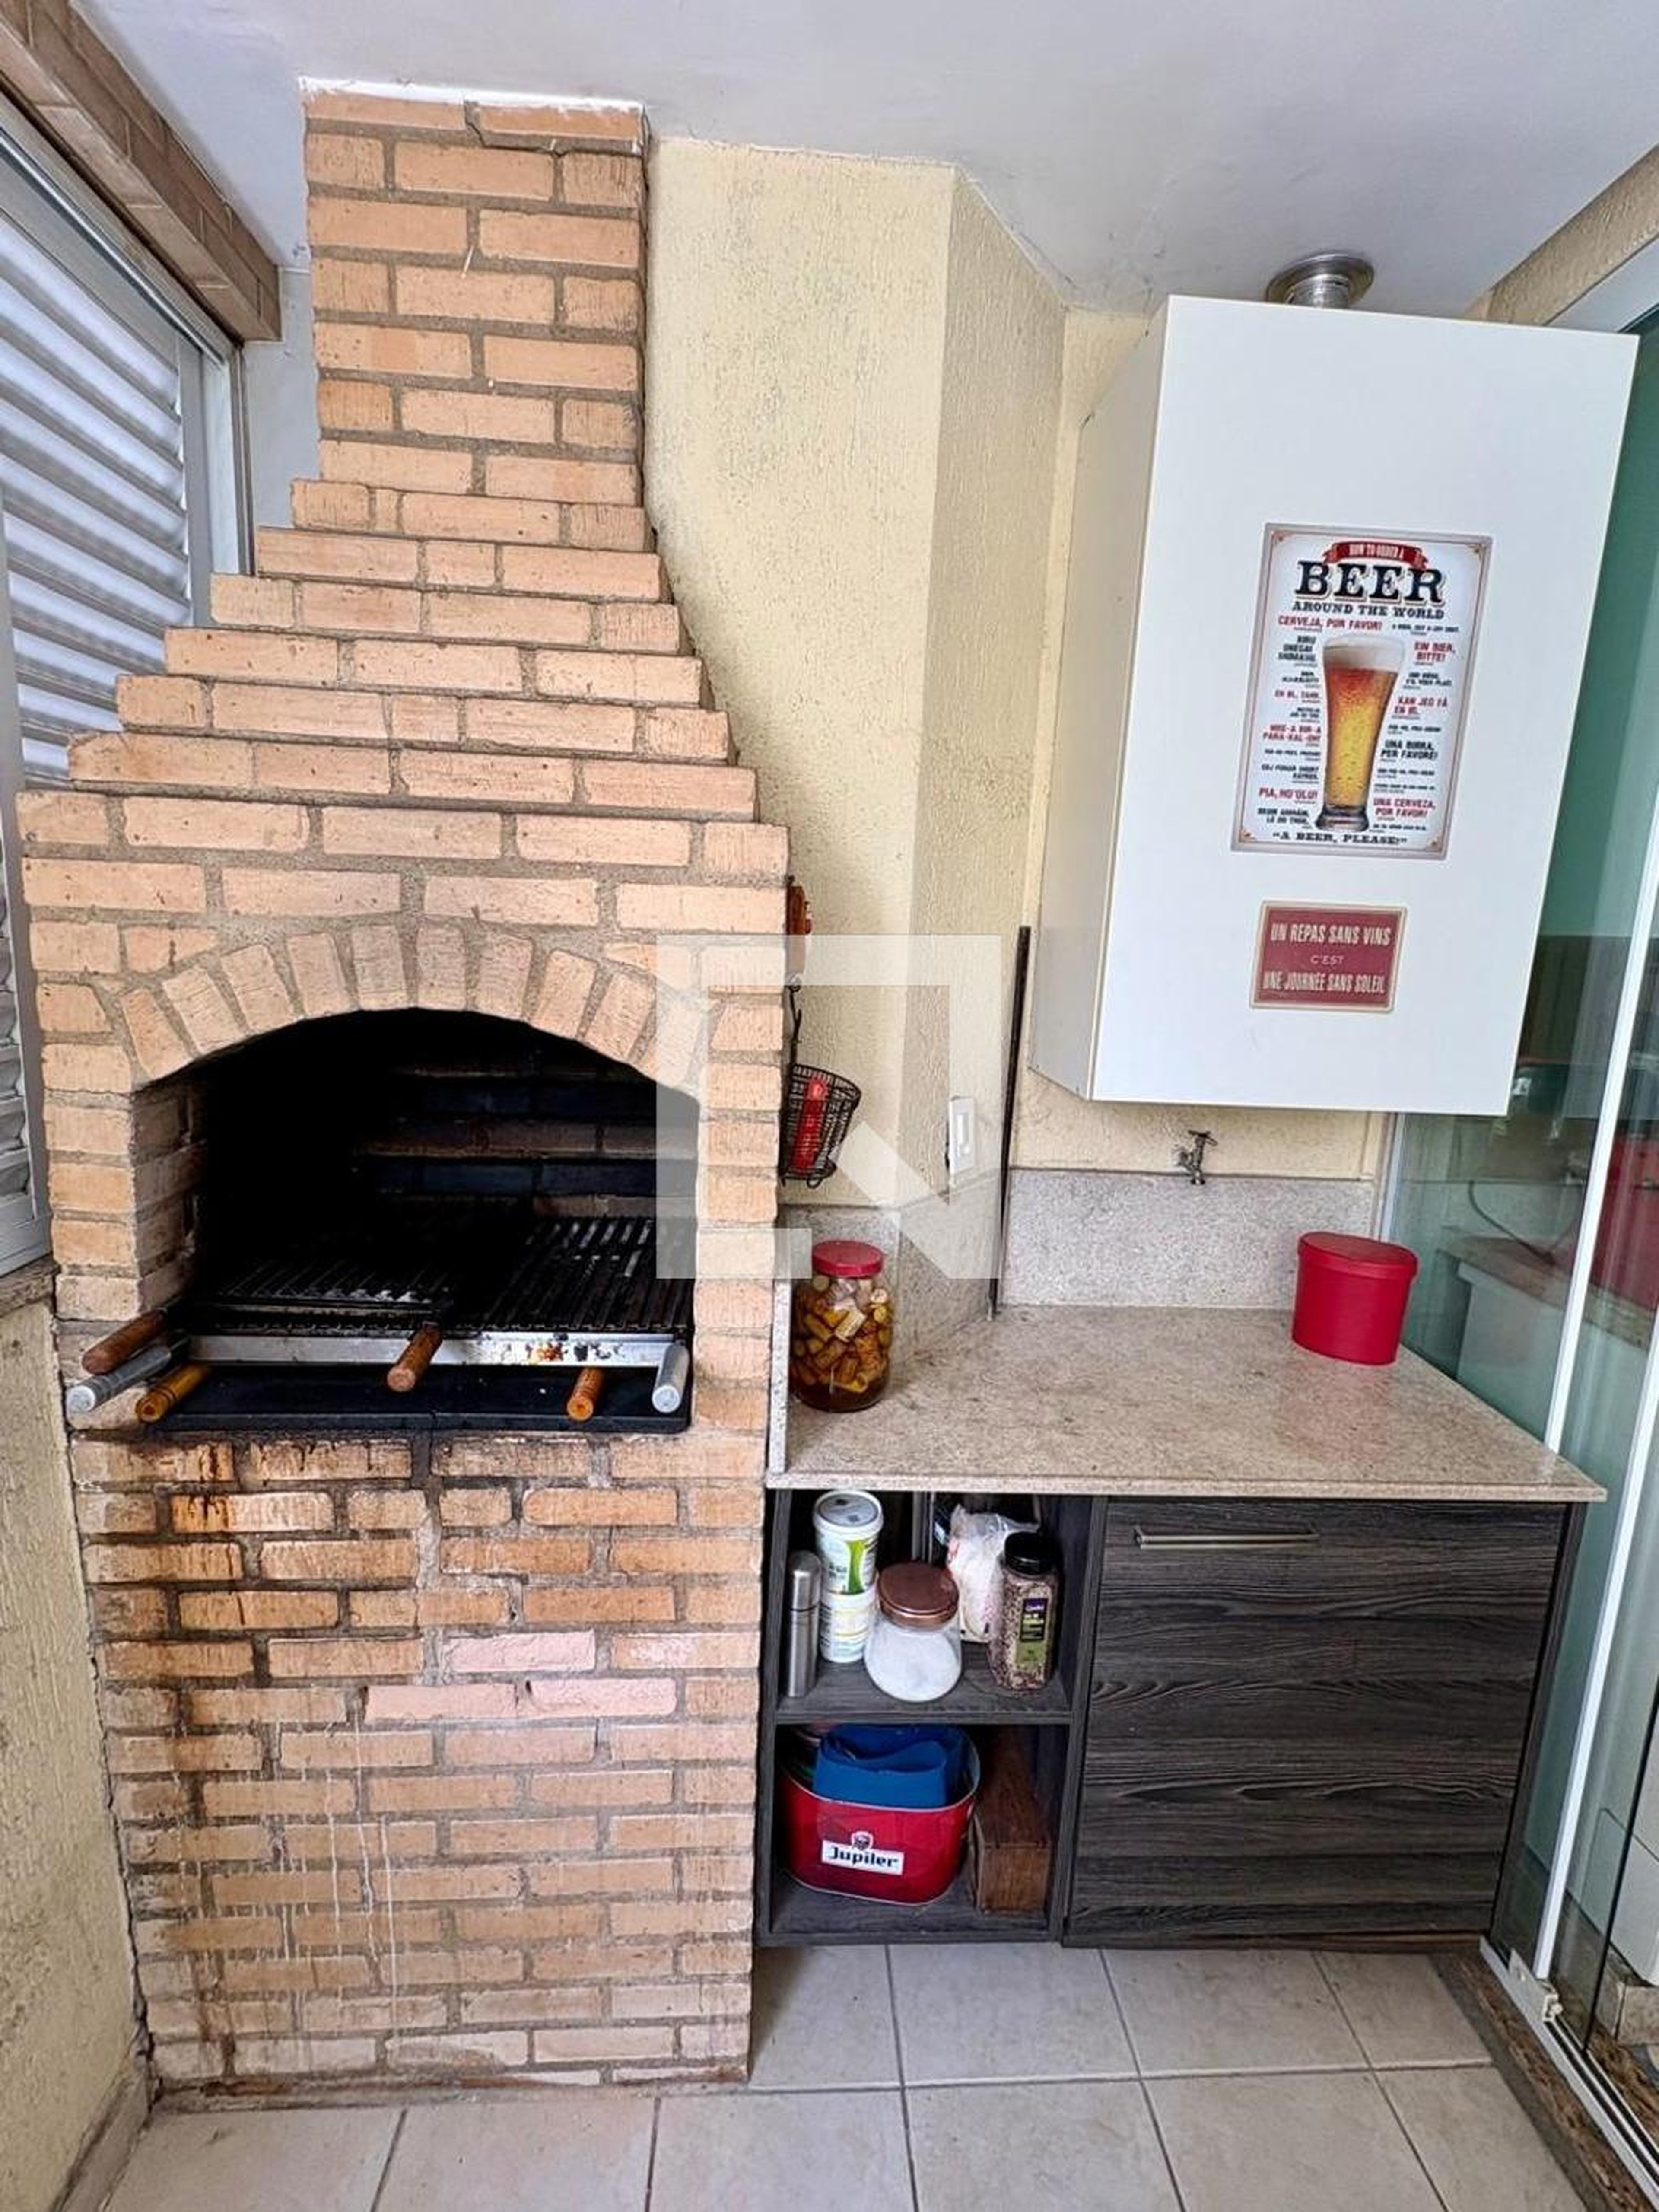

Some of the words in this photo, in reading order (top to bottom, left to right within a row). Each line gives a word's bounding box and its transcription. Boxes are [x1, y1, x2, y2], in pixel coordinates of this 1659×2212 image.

[1366, 544, 1375, 556] TO
[1294, 560, 1444, 605] BEER
[1292, 602, 1353, 614] AROUND
[1358, 605, 1388, 617] THE
[1392, 607, 1444, 619] WORLD
[1326, 618, 1345, 628] POR
[1349, 620, 1382, 631] FAVOR!
[1414, 642, 1430, 651] EIN
[1417, 652, 1446, 662] BITTE!
[1381, 749, 1398, 757] PER
[1375, 808, 1393, 816] POR
[1296, 832, 1338, 843] BEER,
[1270, 923, 1288, 941] UN
[1290, 923, 1326, 943] REPAS
[1328, 925, 1361, 945] SANS
[1363, 926, 1392, 945] VINS
[1310, 955, 1344, 965] C'EST
[1262, 971, 1283, 990] UNE
[1327, 972, 1354, 993] SANS
[1354, 974, 1386, 994] SOLEIL
[830, 1846, 899, 1867] Jupiler
